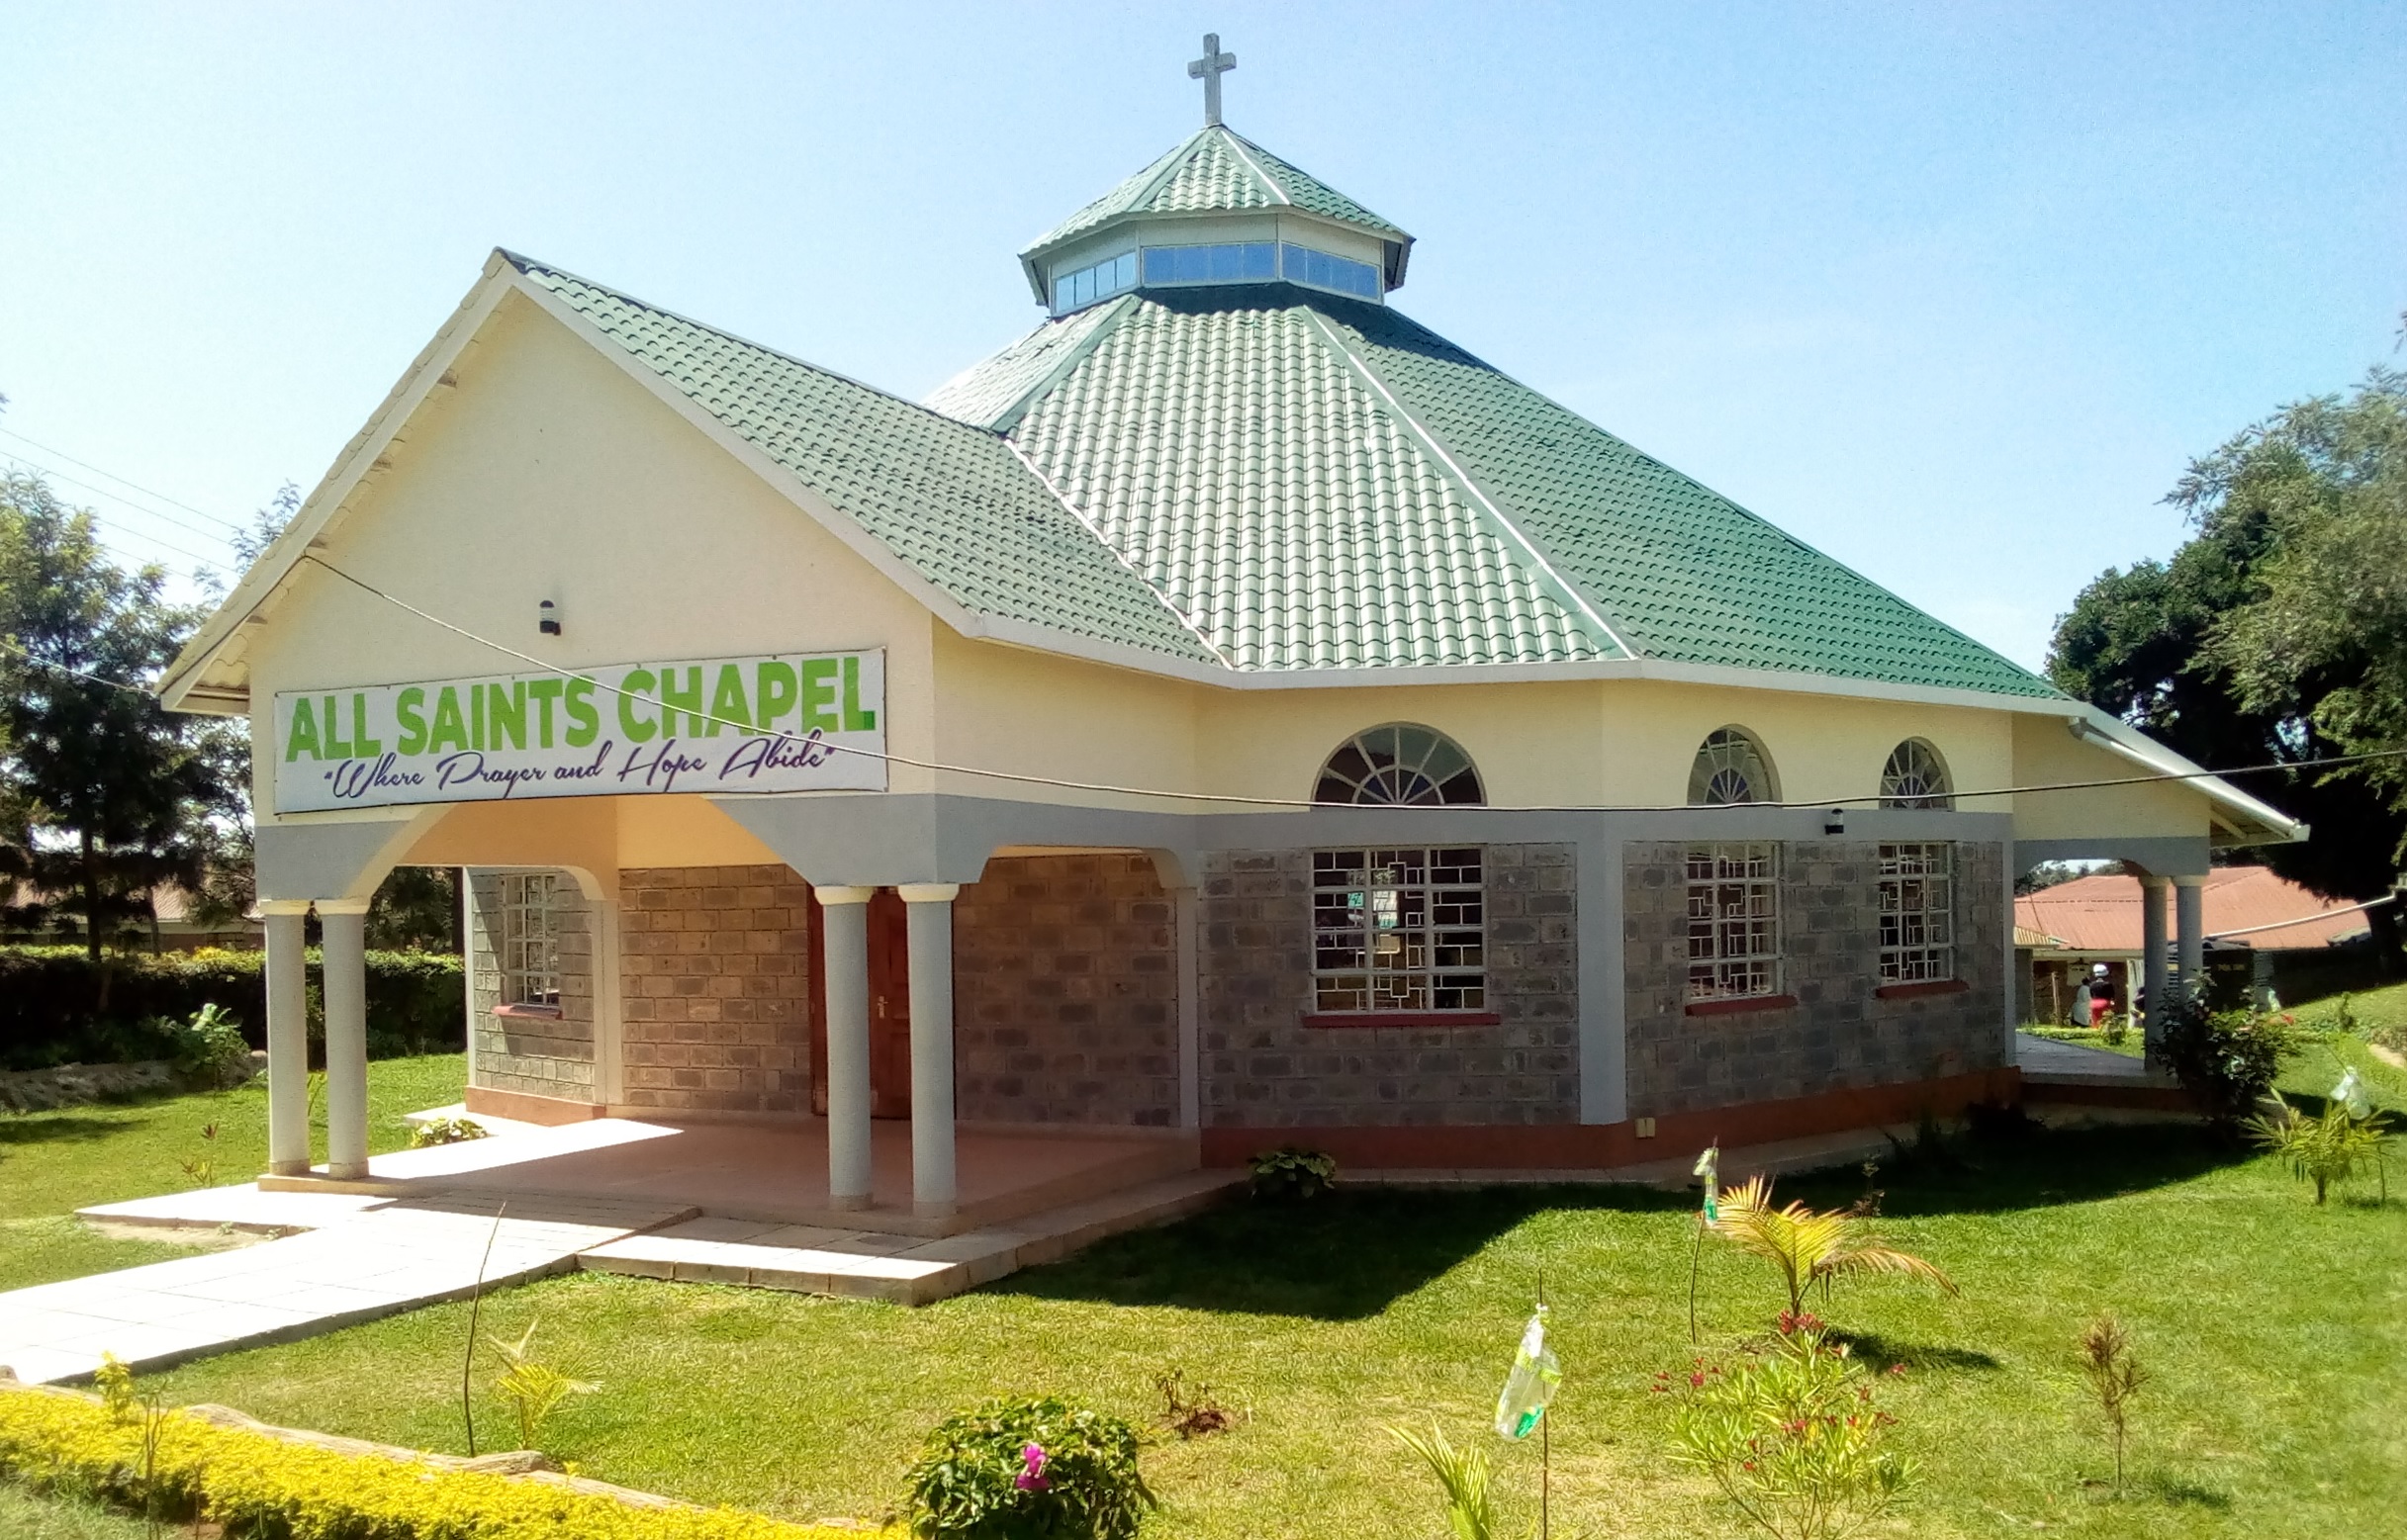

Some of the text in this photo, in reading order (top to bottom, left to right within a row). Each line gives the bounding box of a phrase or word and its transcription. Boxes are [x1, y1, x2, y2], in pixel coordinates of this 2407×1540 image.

[285, 656, 876, 762] ALL SAINTS CHAPEL
[435, 751, 546, 799] Prayer
[554, 740, 612, 779] and
[617, 739, 707, 791] Hope
